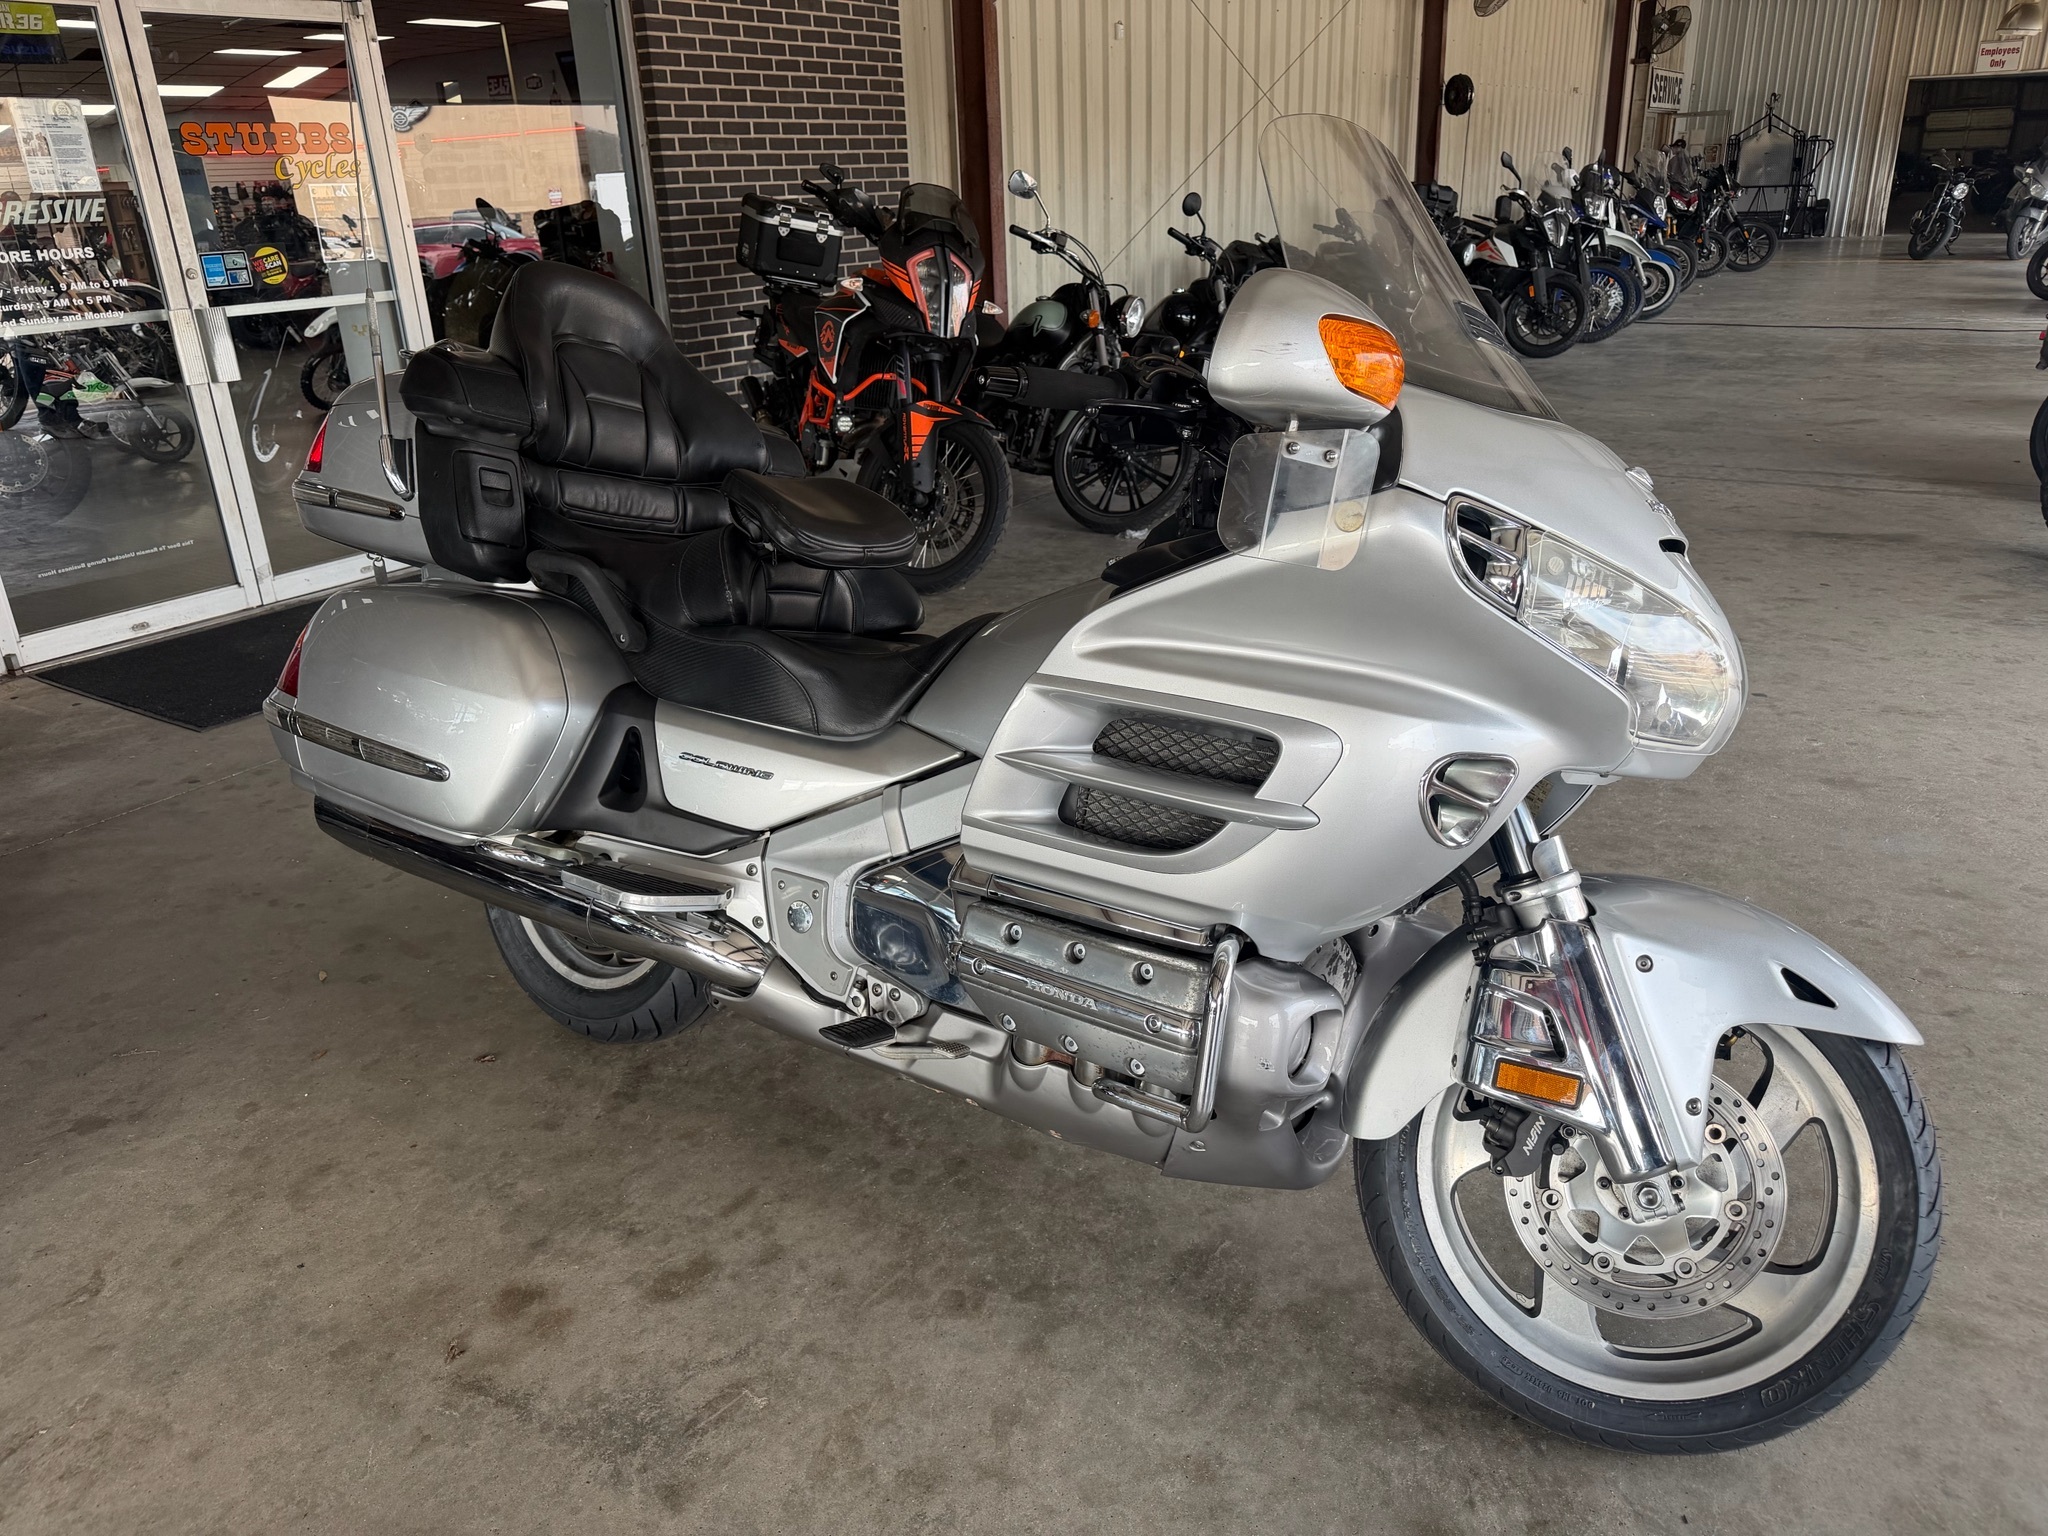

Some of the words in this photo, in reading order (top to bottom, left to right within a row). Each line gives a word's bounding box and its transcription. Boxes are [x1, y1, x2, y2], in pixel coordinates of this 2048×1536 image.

[1980, 47, 2020, 57] Employees
[1990, 59, 2006, 69] Only
[1652, 73, 1683, 105] SERVICE
[180, 122, 353, 155] STUBBS
[274, 152, 361, 190] Cycles
[0, 198, 106, 226] RESSIVE
[37, 247, 95, 261] HOURS
[253, 258, 265, 267] WE
[263, 254, 280, 264] CARE
[255, 265, 267, 273] WE
[265, 260, 282, 269] SCAN
[13, 285, 47, 296] Friday
[61, 283, 67, 291] 9
[70, 281, 87, 290] AM
[89, 280, 99, 289] to
[103, 280, 110, 288] 6
[112, 278, 128, 287] PM
[43, 300, 50, 308] 9
[53, 298, 70, 307] AM
[73, 298, 84, 306] to
[86, 296, 94, 305] 5
[96, 294, 112, 304] PM
[19, 314, 60, 327] Sunday
[63, 312, 84, 321] and
[84, 310, 125, 321] Monday
[1026, 977, 1099, 1012] HONDA
[1759, 1301, 1883, 1408] SHINKO
